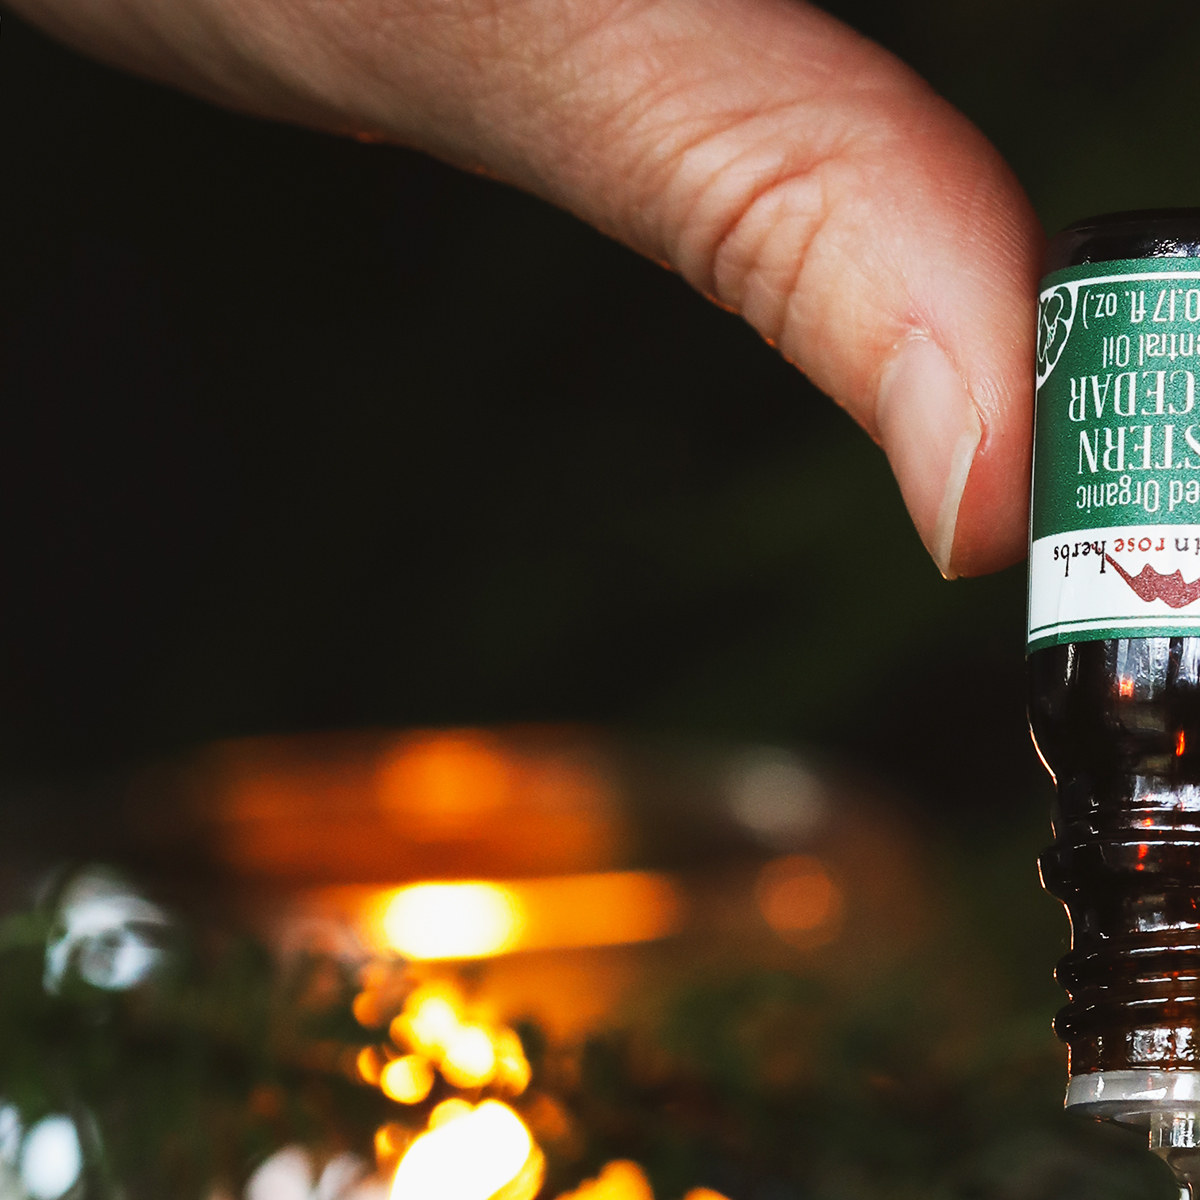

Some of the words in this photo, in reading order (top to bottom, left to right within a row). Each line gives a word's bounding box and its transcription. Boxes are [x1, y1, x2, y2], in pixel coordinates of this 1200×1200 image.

[1082, 291, 1117, 329] oz.)
[1125, 290, 1147, 323] fl.
[1102, 334, 1131, 368] Oil
[1068, 370, 1196, 422] CEDAR
[1075, 475, 1162, 513] Organic
[1053, 540, 1108, 578] herbs
[1114, 536, 1165, 553] rose
